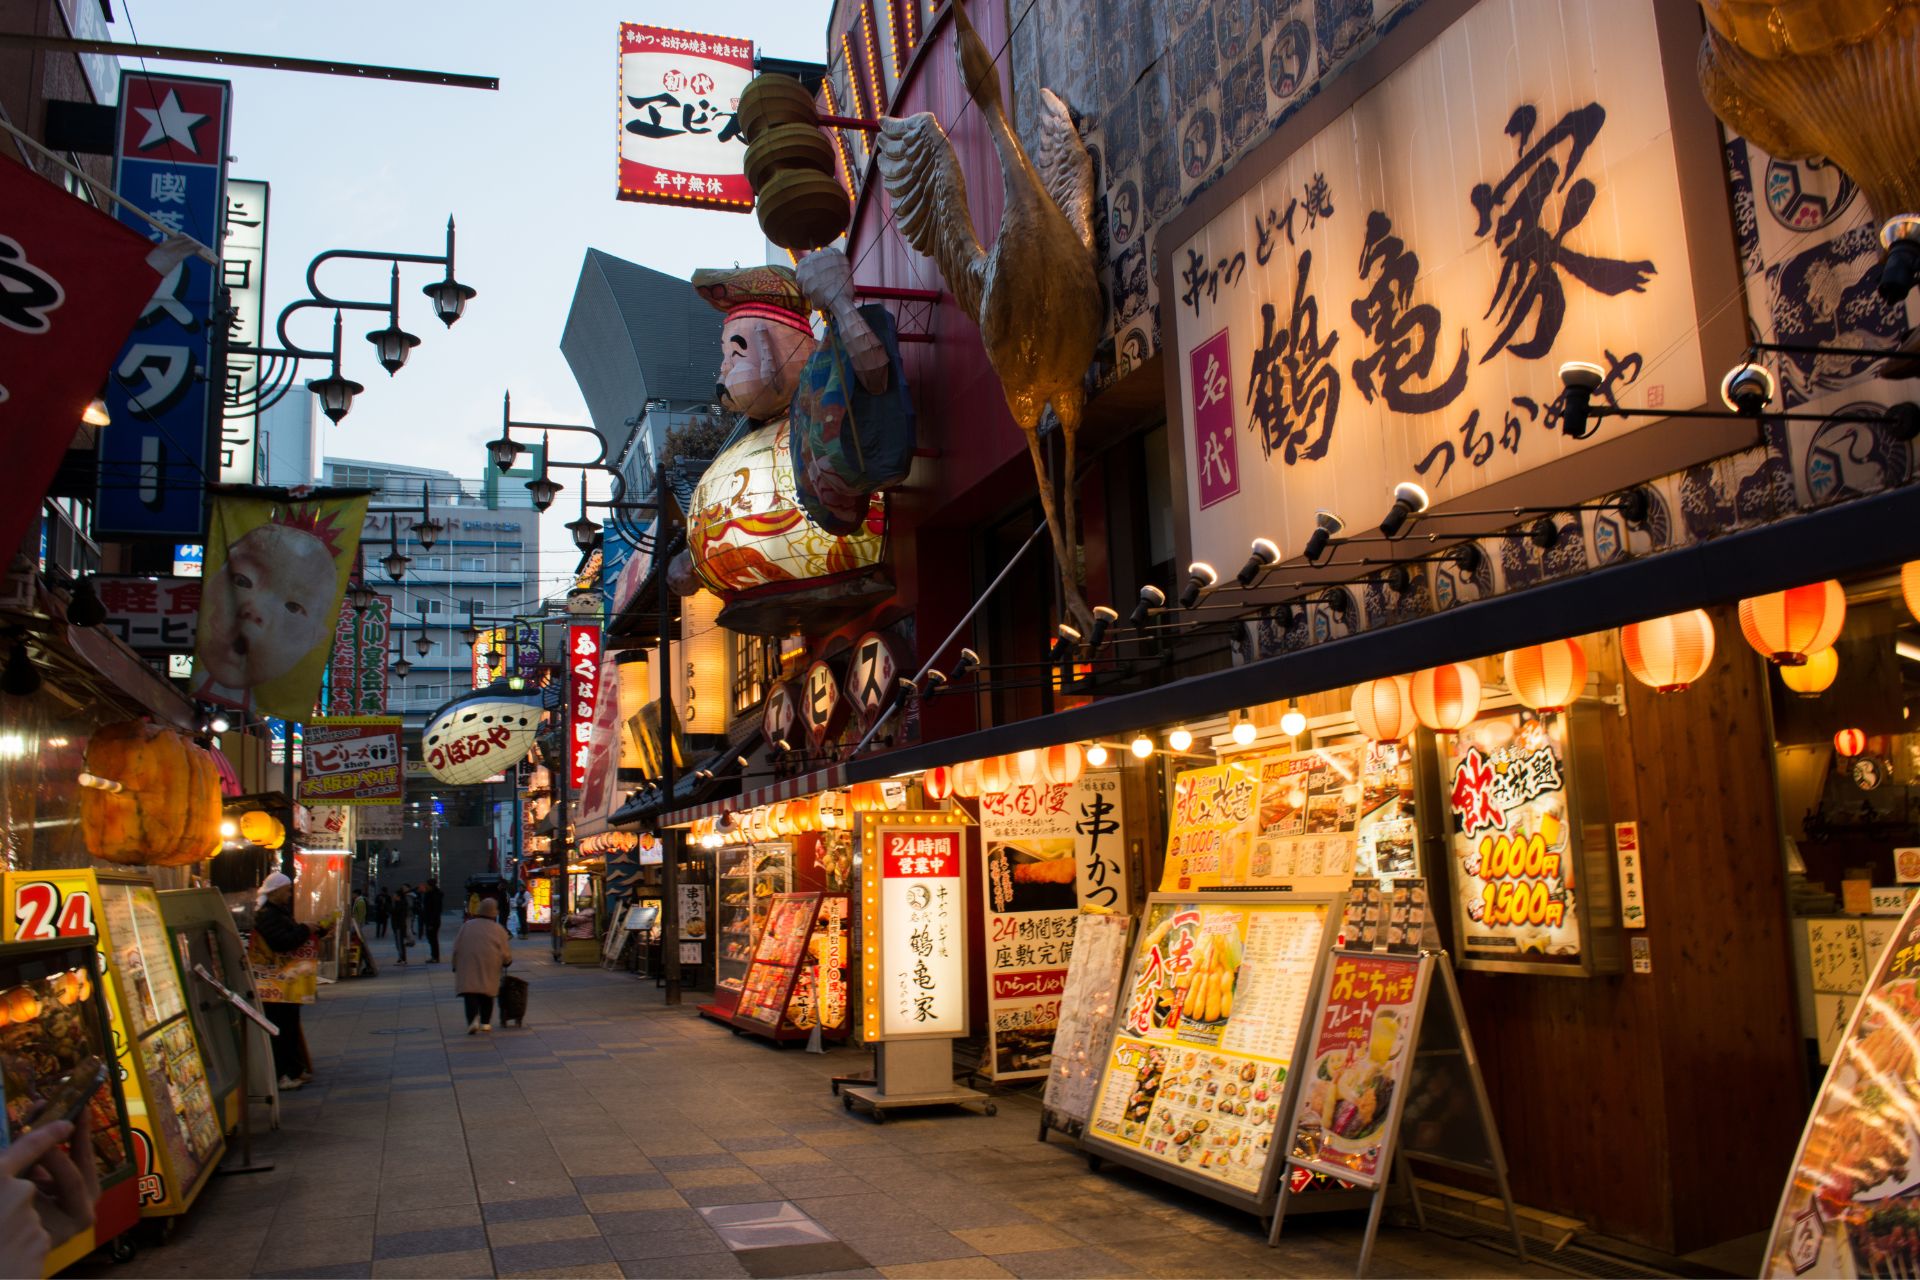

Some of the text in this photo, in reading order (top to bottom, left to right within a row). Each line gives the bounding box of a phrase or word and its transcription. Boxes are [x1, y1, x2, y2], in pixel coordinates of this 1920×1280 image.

[653, 171, 724, 195] 年中無休
[1182, 172, 1335, 318] 串かつ どて焼
[1248, 101, 1658, 466] 鶴亀家
[1198, 352, 1232, 486] 名代
[365, 514, 461, 533] スワルド
[101, 581, 201, 614] 軽食
[106, 617, 196, 643] コーヒ
[362, 600, 387, 715] 大小宴会承
[313, 743, 370, 771] ビリーズ
[428, 724, 511, 771] づぼらや
[344, 760, 370, 770] shop
[304, 767, 397, 795] 大阪みやげ
[1452, 748, 1560, 838] 飲み放題
[1177, 768, 1253, 828] 飲み放題
[891, 838, 951, 856] 24時間
[1076, 793, 1121, 907] 串かつ
[898, 857, 945, 875] 営業中
[686, 887, 700, 916] 串かつ
[994, 941, 1074, 968] 座敷完備
[909, 924, 939, 1022] 鶴亀家
[1332, 961, 1415, 1002] おこちゃま
[1327, 1001, 1374, 1030] プレート
